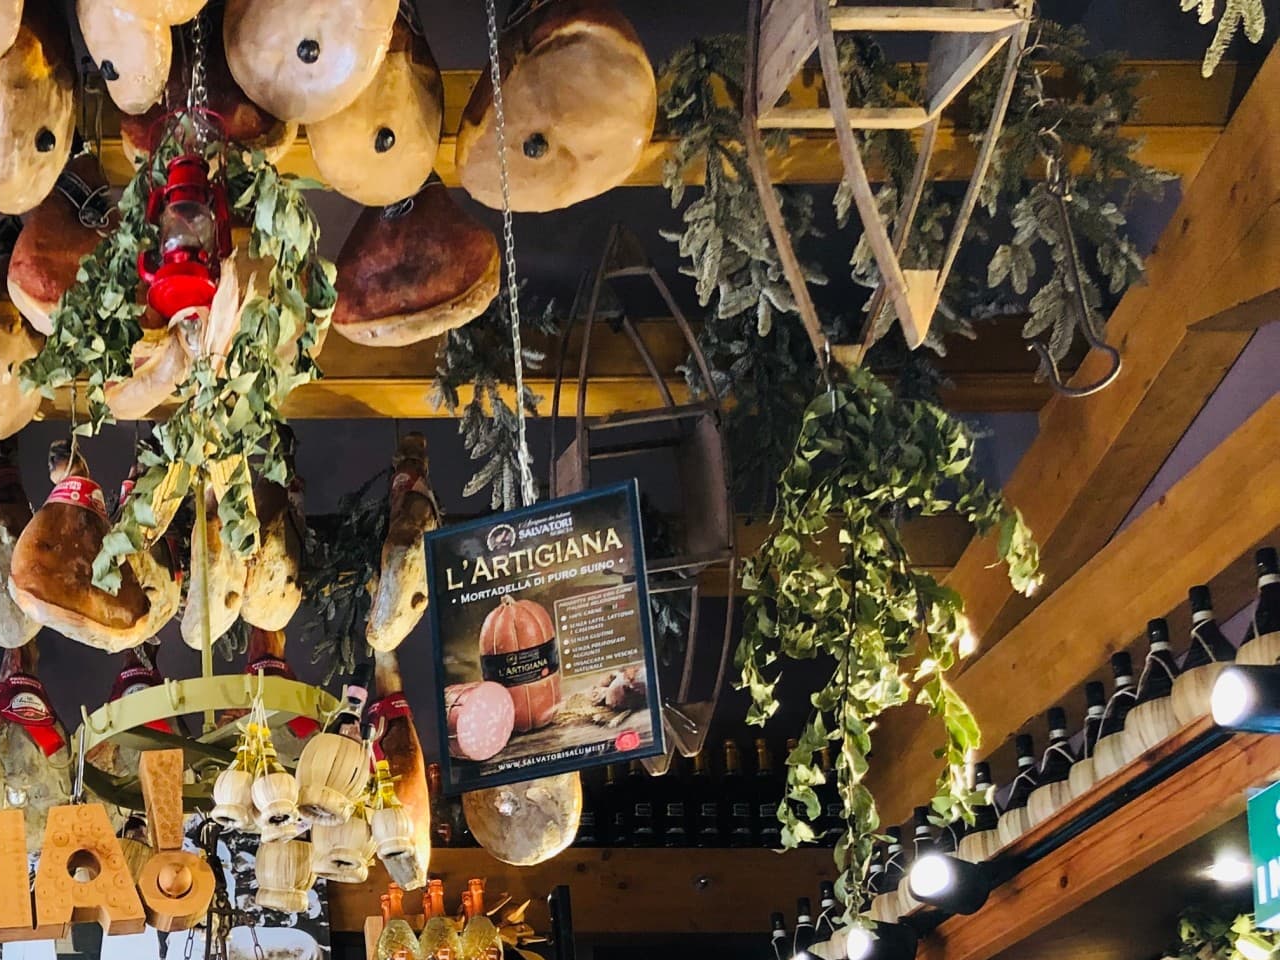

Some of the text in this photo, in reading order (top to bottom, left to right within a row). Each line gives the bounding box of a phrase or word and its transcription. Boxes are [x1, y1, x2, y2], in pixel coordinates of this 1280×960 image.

[518, 517, 573, 539] SALVATORI
[446, 528, 623, 591] L'ARTIGIANA
[461, 560, 615, 604] MORTADELLA DI PURO SUINO
